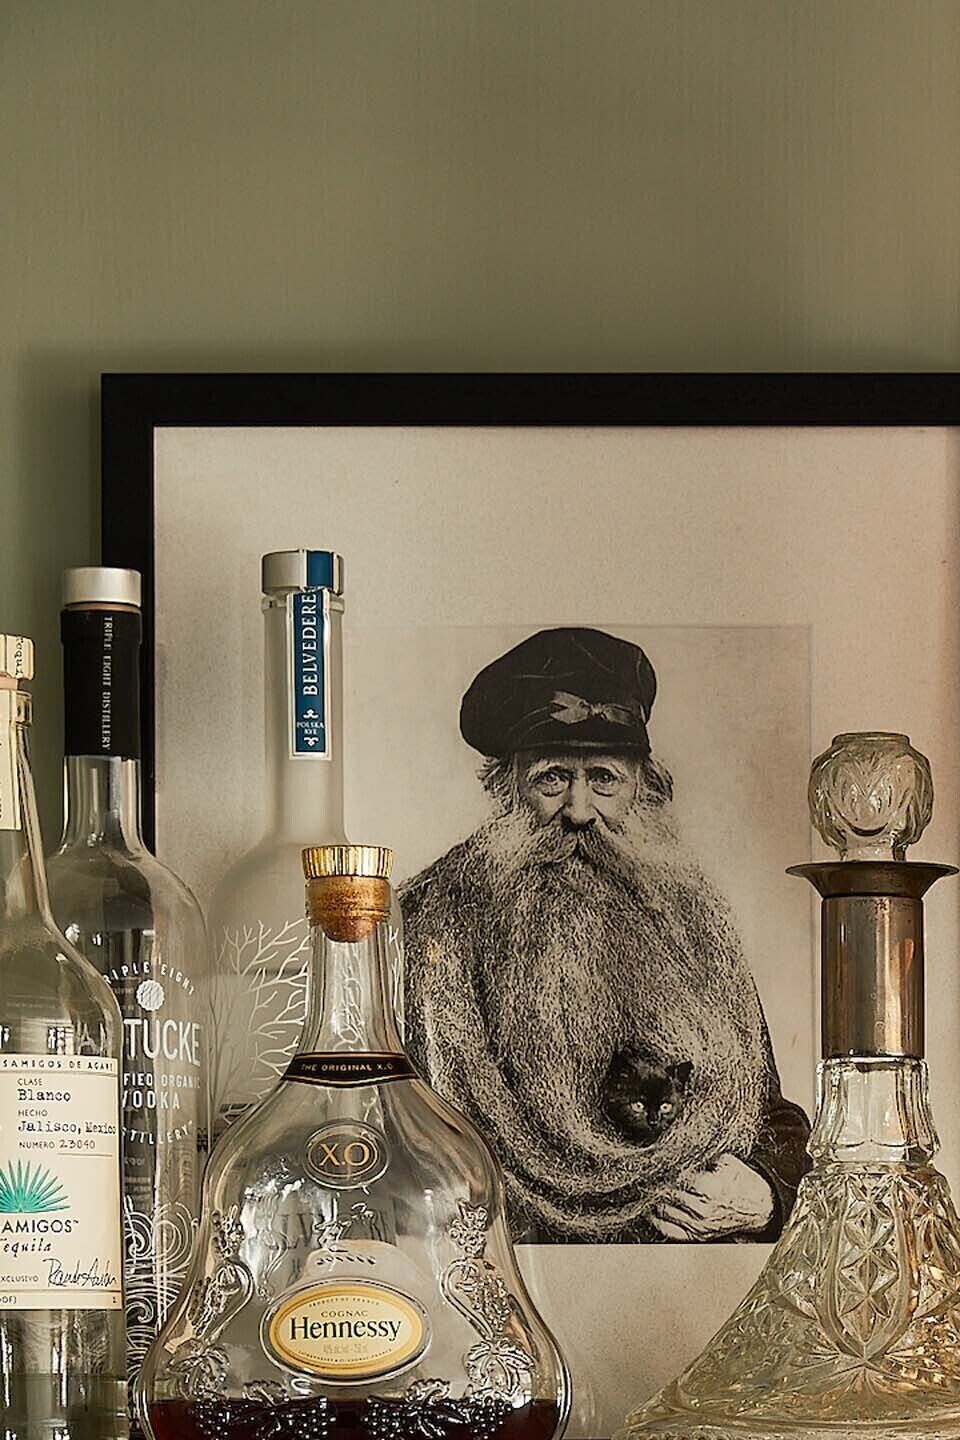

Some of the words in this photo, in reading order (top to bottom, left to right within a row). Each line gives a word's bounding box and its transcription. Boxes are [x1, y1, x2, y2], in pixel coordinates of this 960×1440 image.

[103, 615, 113, 651] TRIPLE
[302, 592, 318, 696] BELVEDERE
[103, 655, 112, 687] EIGHT
[101, 691, 112, 750] DISTILLERY
[301, 1063, 317, 1072] THE
[321, 1063, 373, 1072] ORIGINAL
[17, 1078, 43, 1086] CLASE
[17, 1088, 72, 1102] Blanco
[18, 1109, 48, 1117] HECHO
[18, 1120, 81, 1135] Jalisco,
[320, 1310, 369, 1318] COGNAC
[290, 1316, 402, 1342] Hennessy
